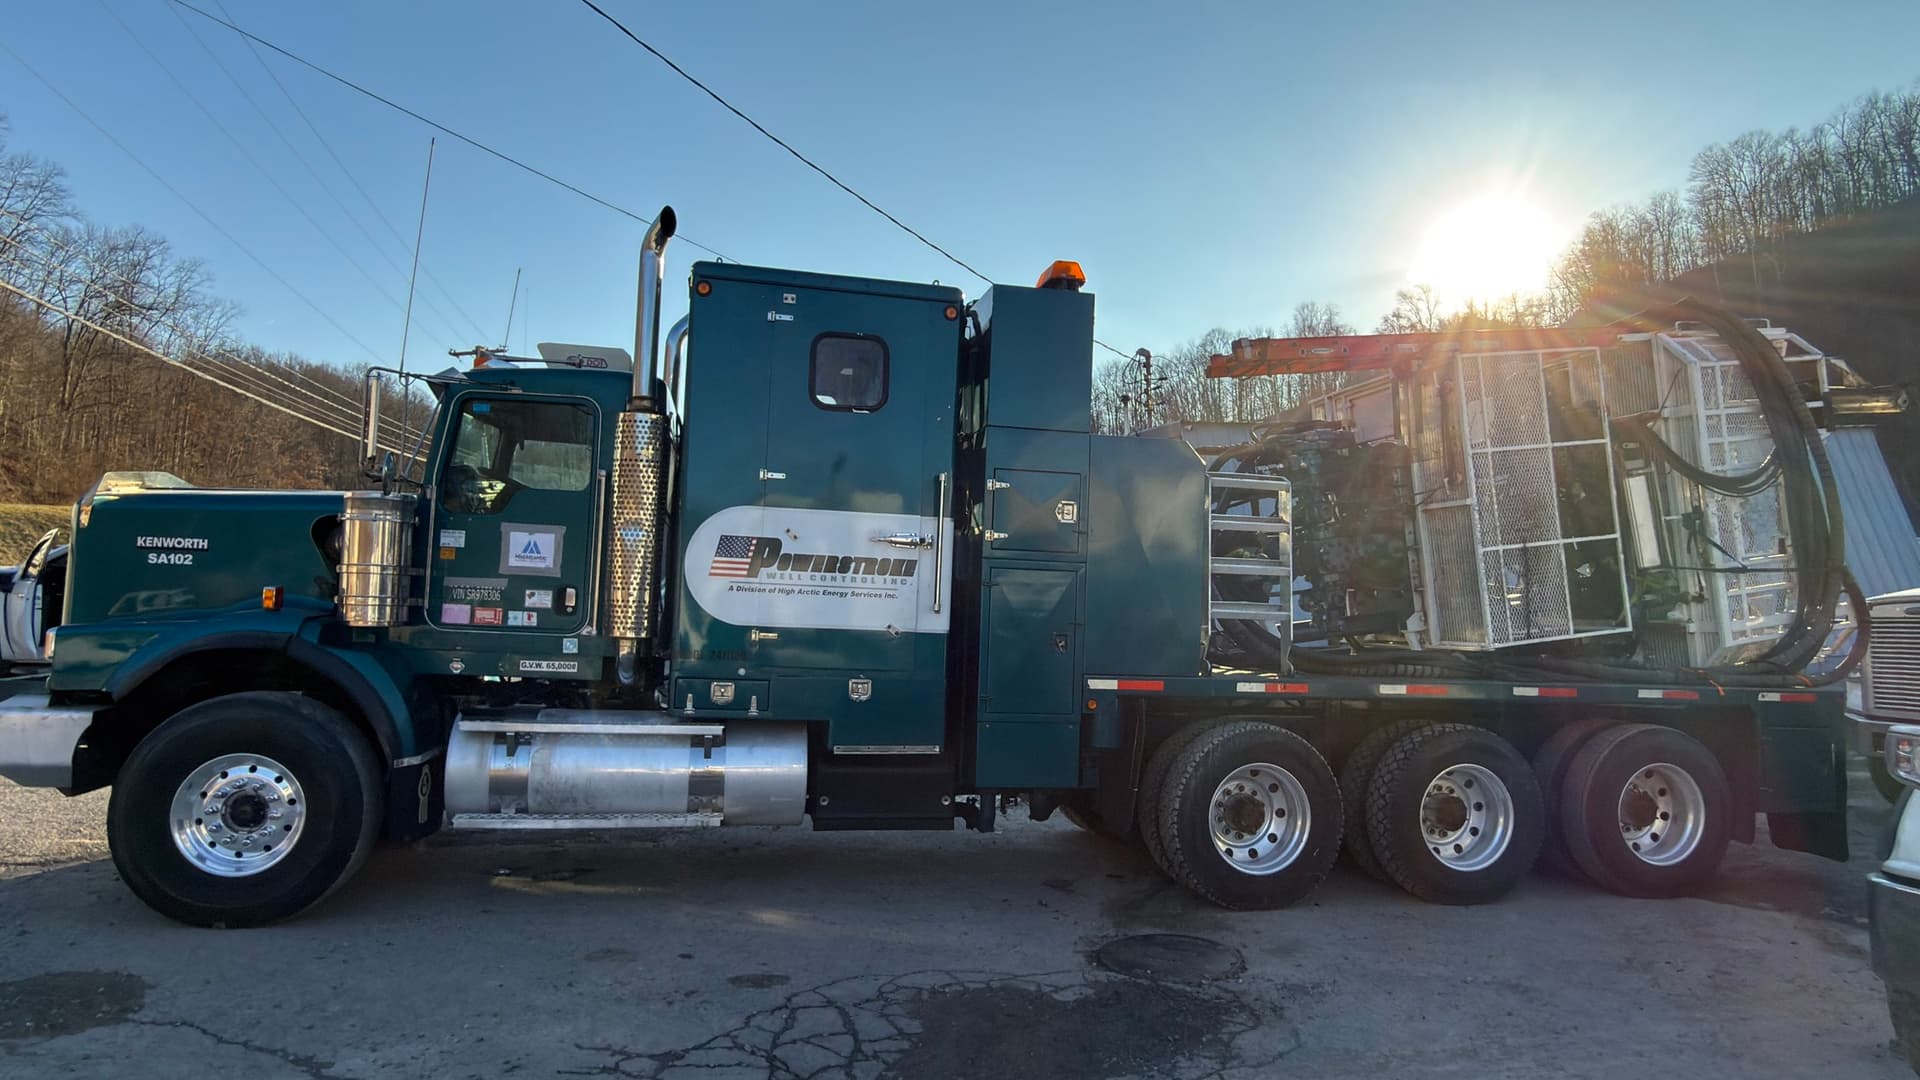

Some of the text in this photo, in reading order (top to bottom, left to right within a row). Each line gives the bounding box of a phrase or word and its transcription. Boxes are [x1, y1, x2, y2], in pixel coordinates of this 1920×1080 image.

[136, 536, 209, 549] KENWORTH
[147, 553, 193, 565] SA102
[766, 572, 913, 586] WELL CONTROL INC.
[452, 588, 465, 600] VIN
[736, 585, 767, 593] Division
[778, 587, 795, 596] High
[797, 588, 820, 596] Arctic
[822, 589, 848, 598] Energy
[850, 591, 882, 599] Services
